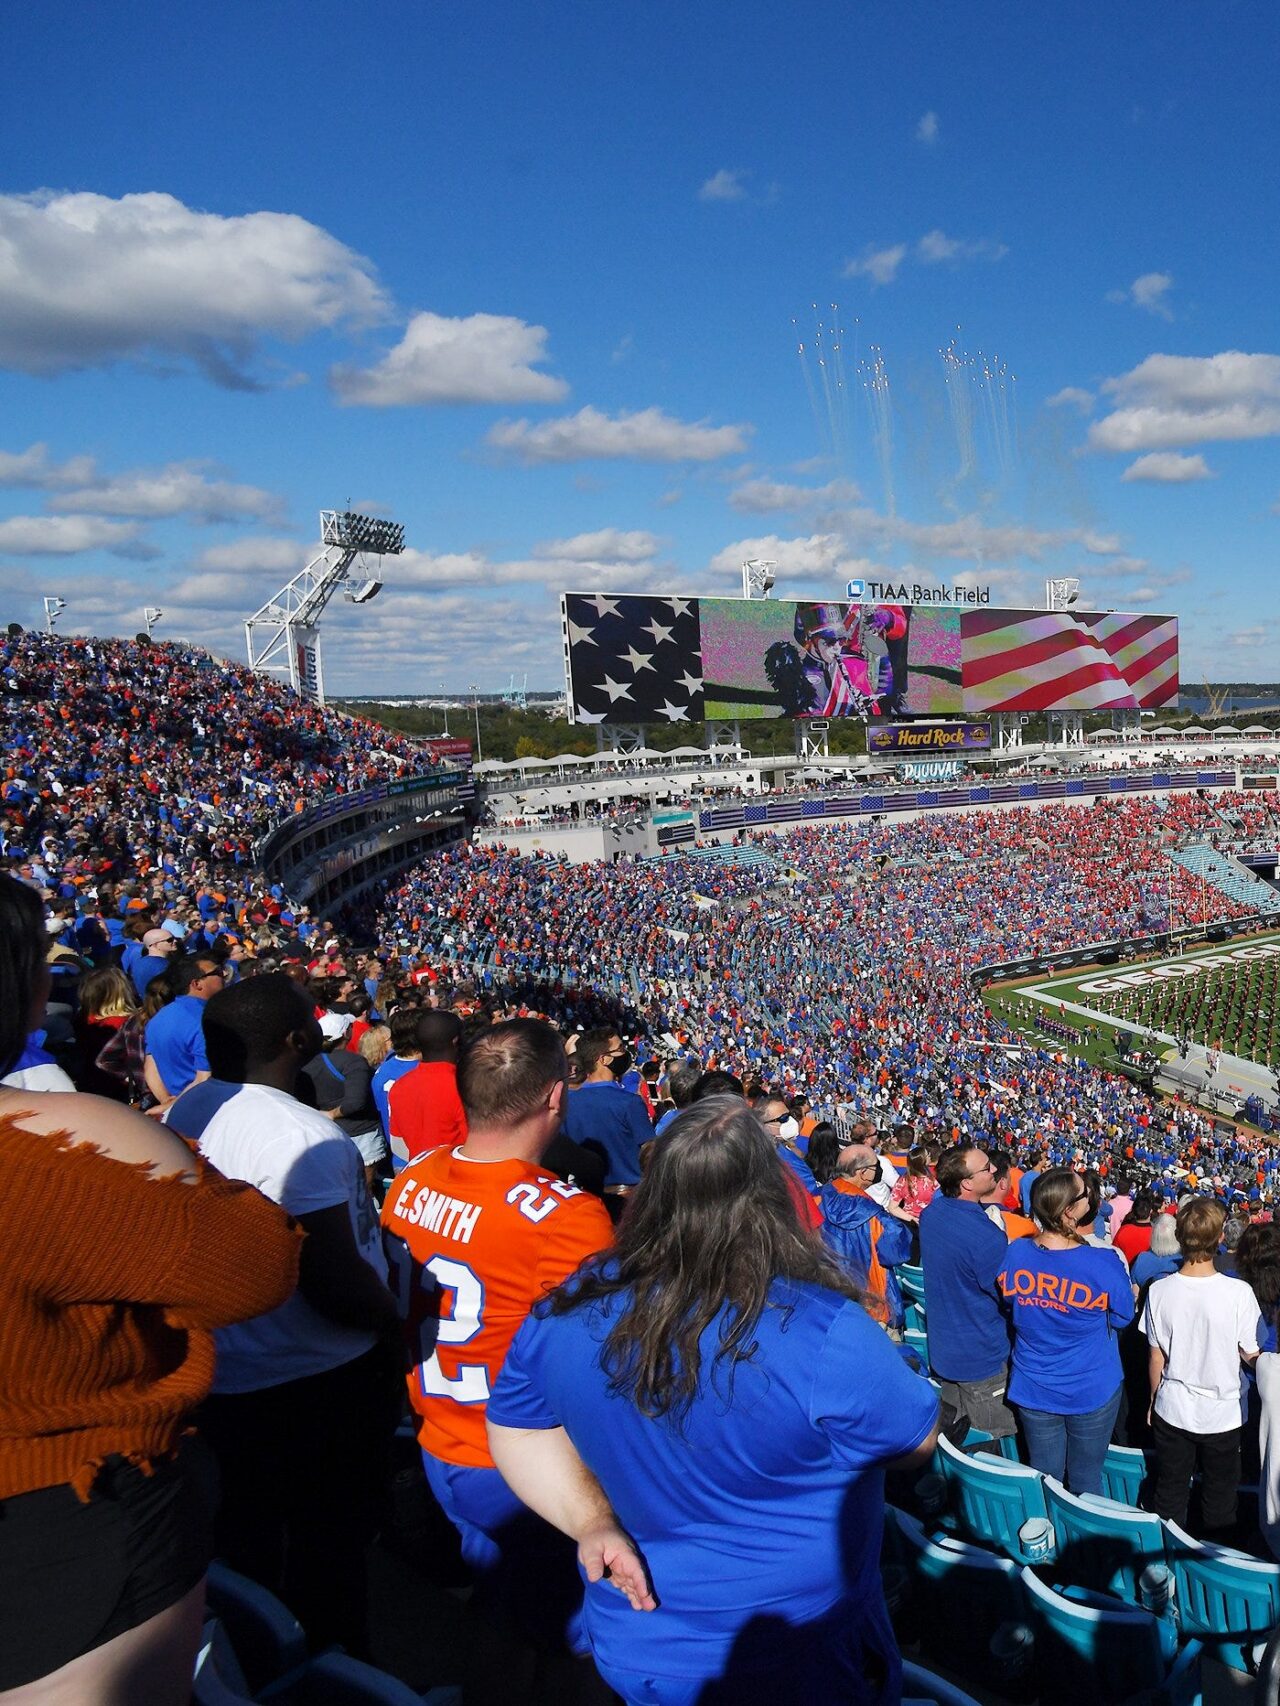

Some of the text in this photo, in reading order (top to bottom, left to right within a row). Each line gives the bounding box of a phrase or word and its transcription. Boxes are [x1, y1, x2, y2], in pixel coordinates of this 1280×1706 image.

[867, 582, 990, 604] TIAA Bank Field
[897, 729, 933, 746] Hard
[933, 728, 965, 747] Rock
[393, 1178, 483, 1244] E.SMITH
